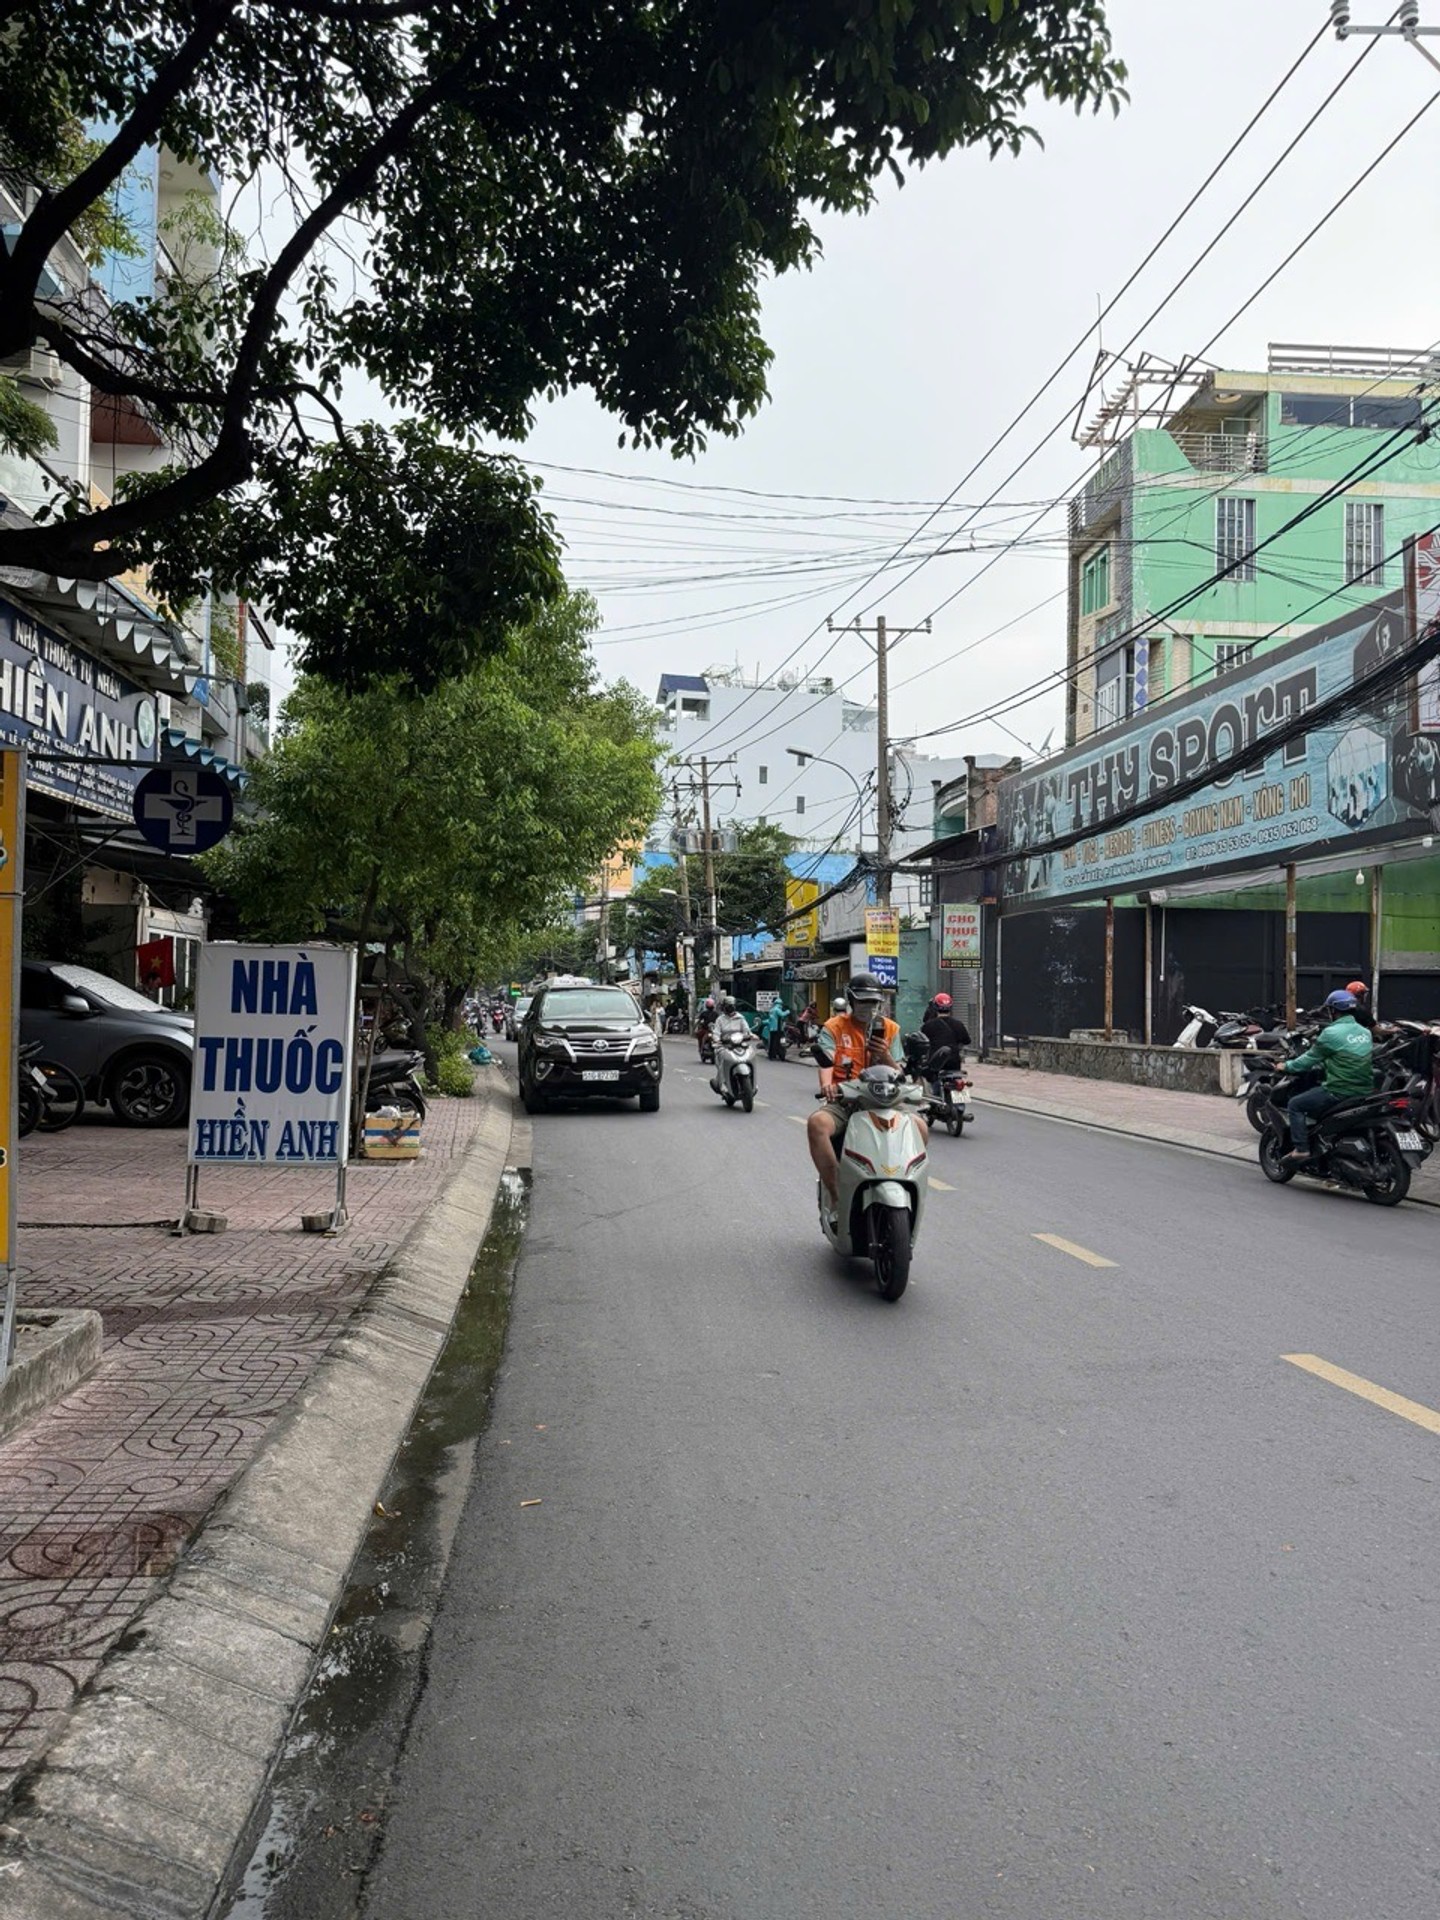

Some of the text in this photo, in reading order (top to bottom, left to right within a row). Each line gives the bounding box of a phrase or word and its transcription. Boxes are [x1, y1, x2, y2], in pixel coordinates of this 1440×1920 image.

[15, 619, 39, 655] NHÀ
[43, 636, 77, 678] THUỐC
[80, 703, 138, 762] ANH
[1289, 771, 1311, 812] HƠI
[231, 952, 318, 1015] NHÀ
[199, 1024, 344, 1094] THUỐC
[194, 1096, 339, 1160] HIỀN ANH
